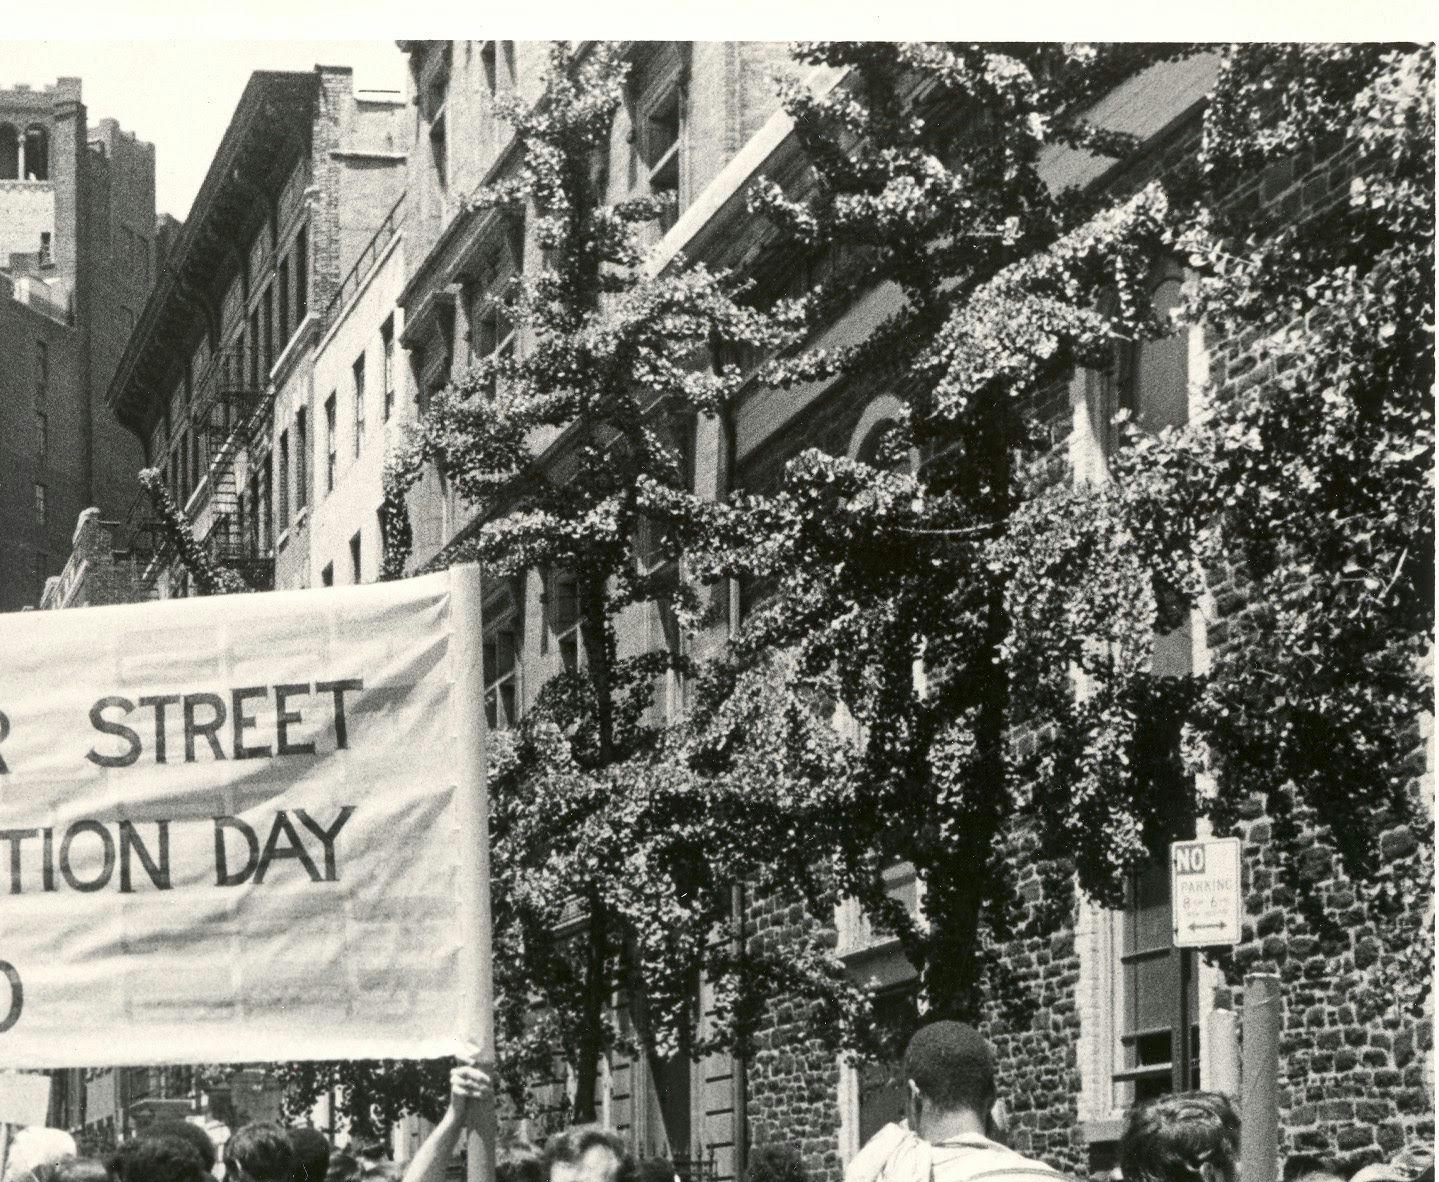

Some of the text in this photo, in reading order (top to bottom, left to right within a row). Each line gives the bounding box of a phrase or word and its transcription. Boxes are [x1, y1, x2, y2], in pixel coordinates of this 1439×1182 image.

[85, 679, 364, 768] STREET
[215, 806, 357, 887] DAY
[1176, 847, 1204, 872] NO
[1180, 879, 1232, 893] PARKING
